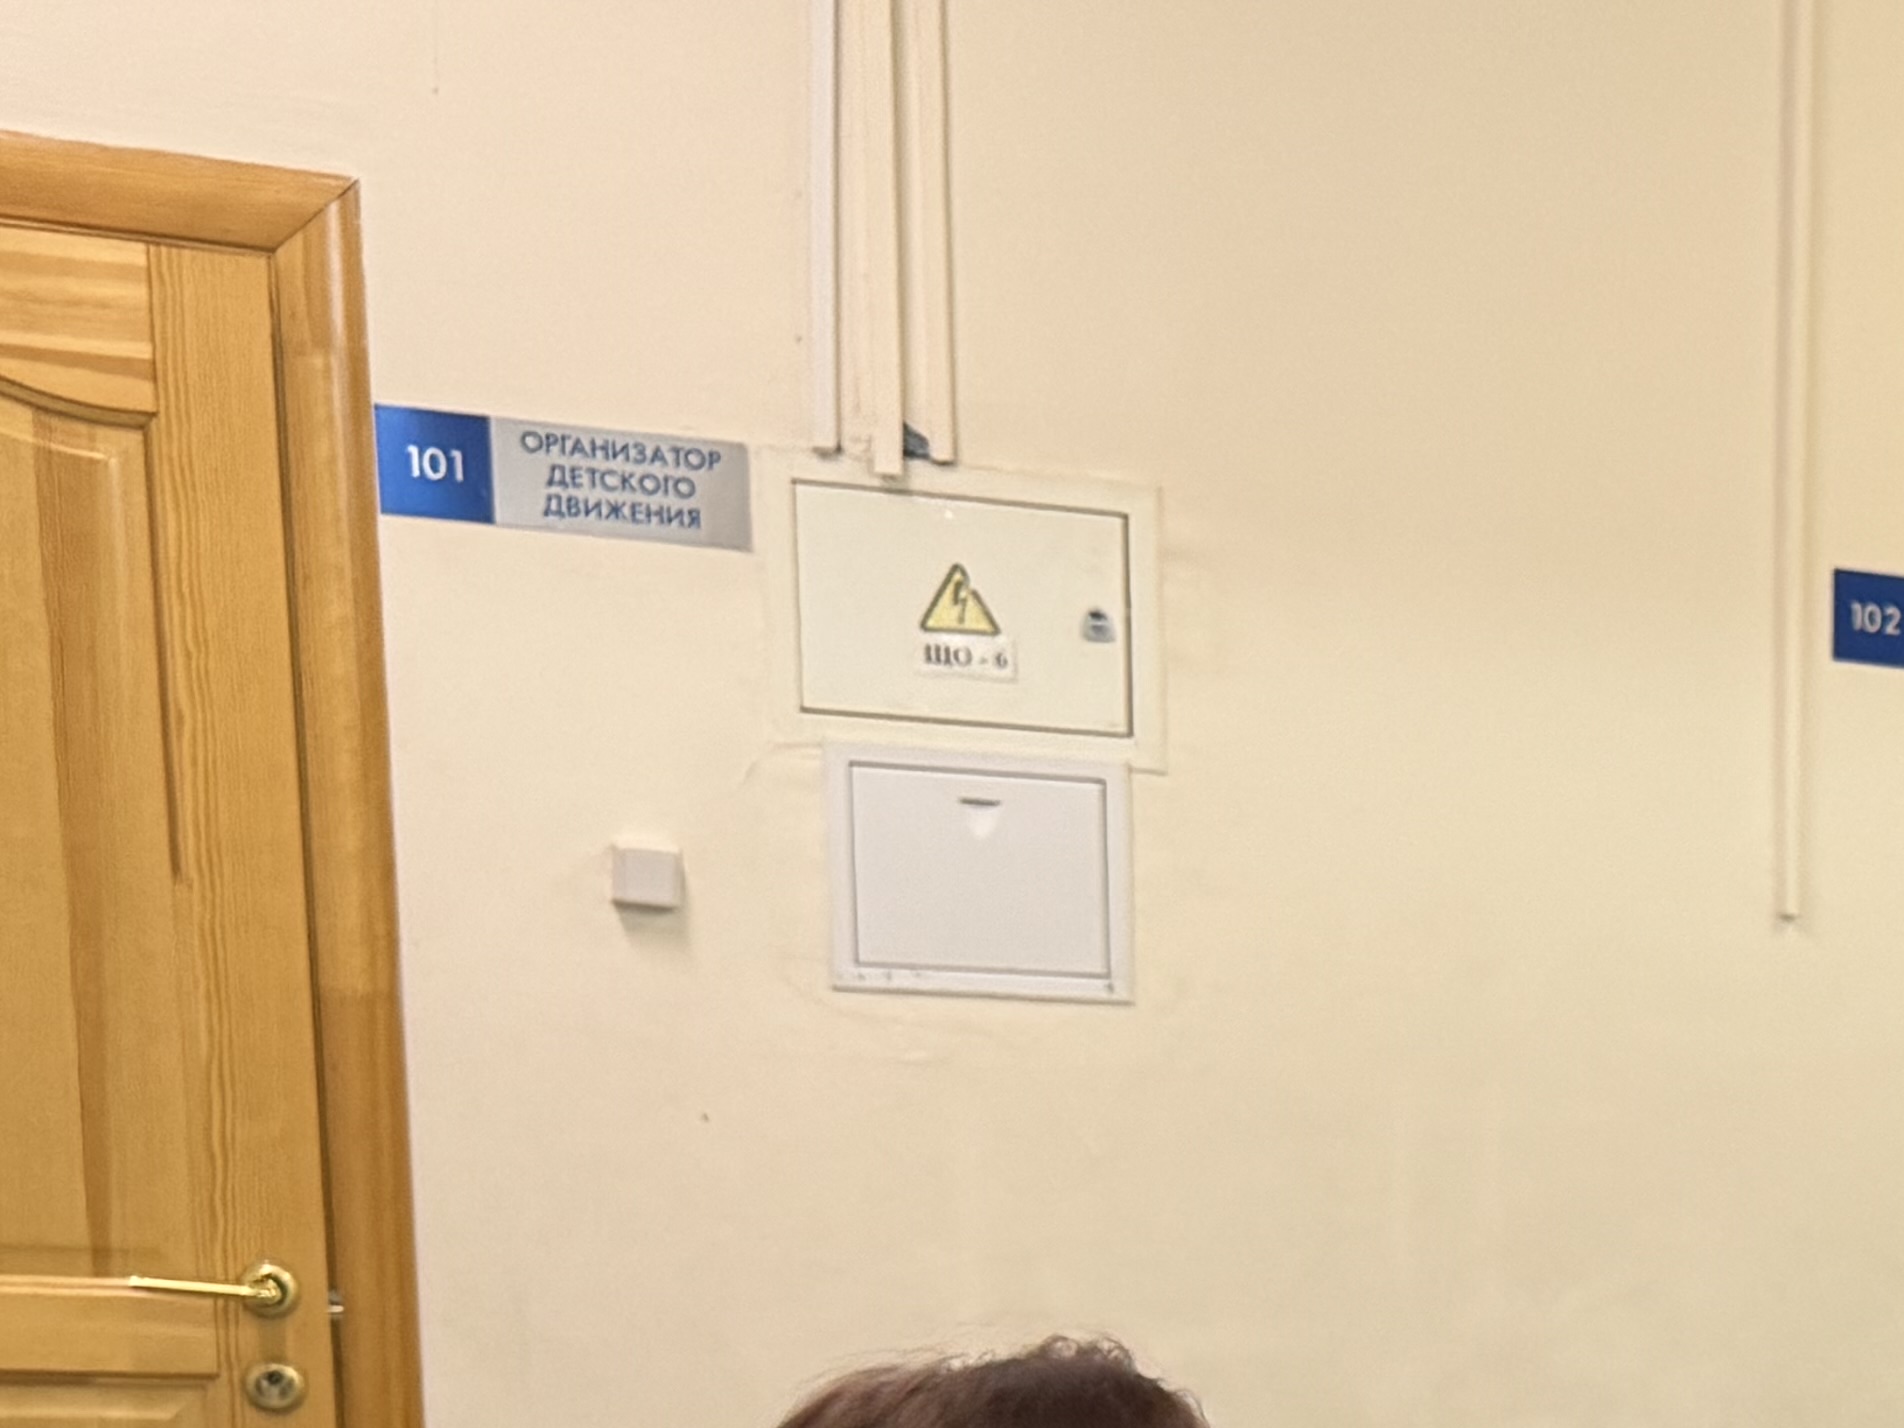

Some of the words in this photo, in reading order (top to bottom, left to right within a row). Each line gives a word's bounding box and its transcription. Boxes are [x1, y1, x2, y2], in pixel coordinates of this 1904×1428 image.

[407, 444, 464, 483] 101
[520, 430, 721, 472] ОРГАНИЗАТОР
[545, 463, 696, 499] ДЕТСКОГО
[543, 494, 702, 529] ДВИЖЕНИЯ
[1850, 602, 1902, 636] 102
